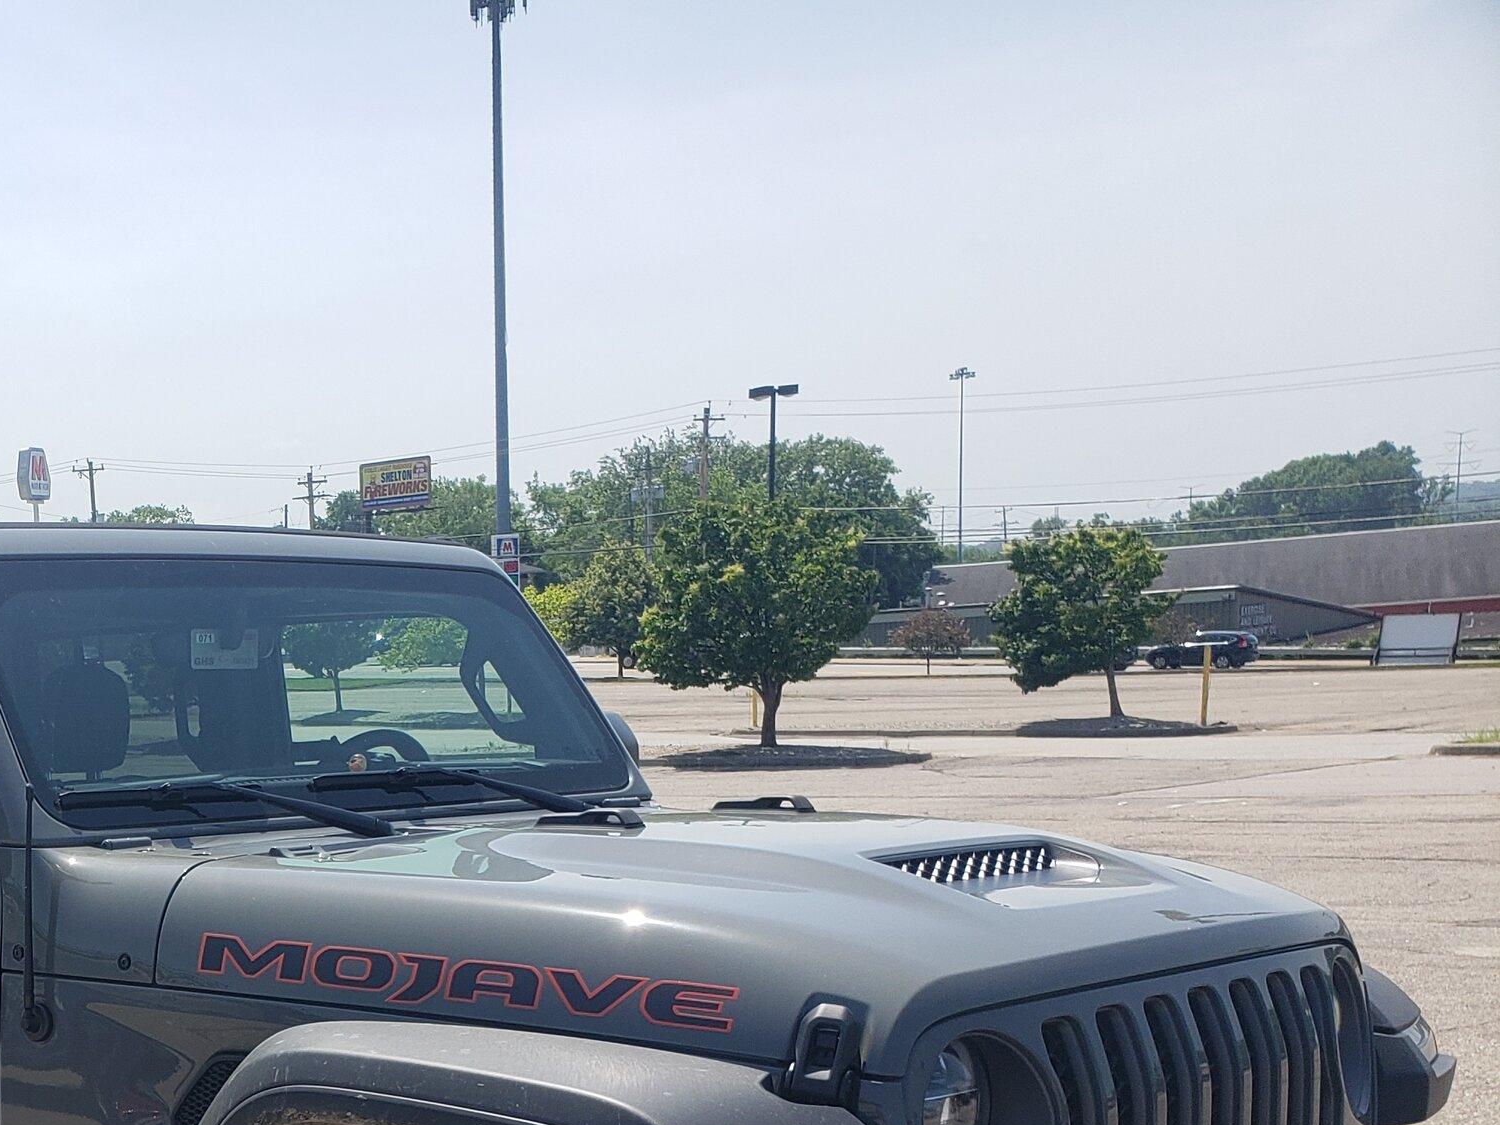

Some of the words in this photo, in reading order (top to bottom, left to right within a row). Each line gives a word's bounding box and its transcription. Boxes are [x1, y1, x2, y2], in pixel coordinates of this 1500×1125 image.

[32, 456, 47, 481] M
[503, 542, 512, 551] M
[198, 634, 212, 643] 071
[198, 932, 740, 1033] MOJAVE
